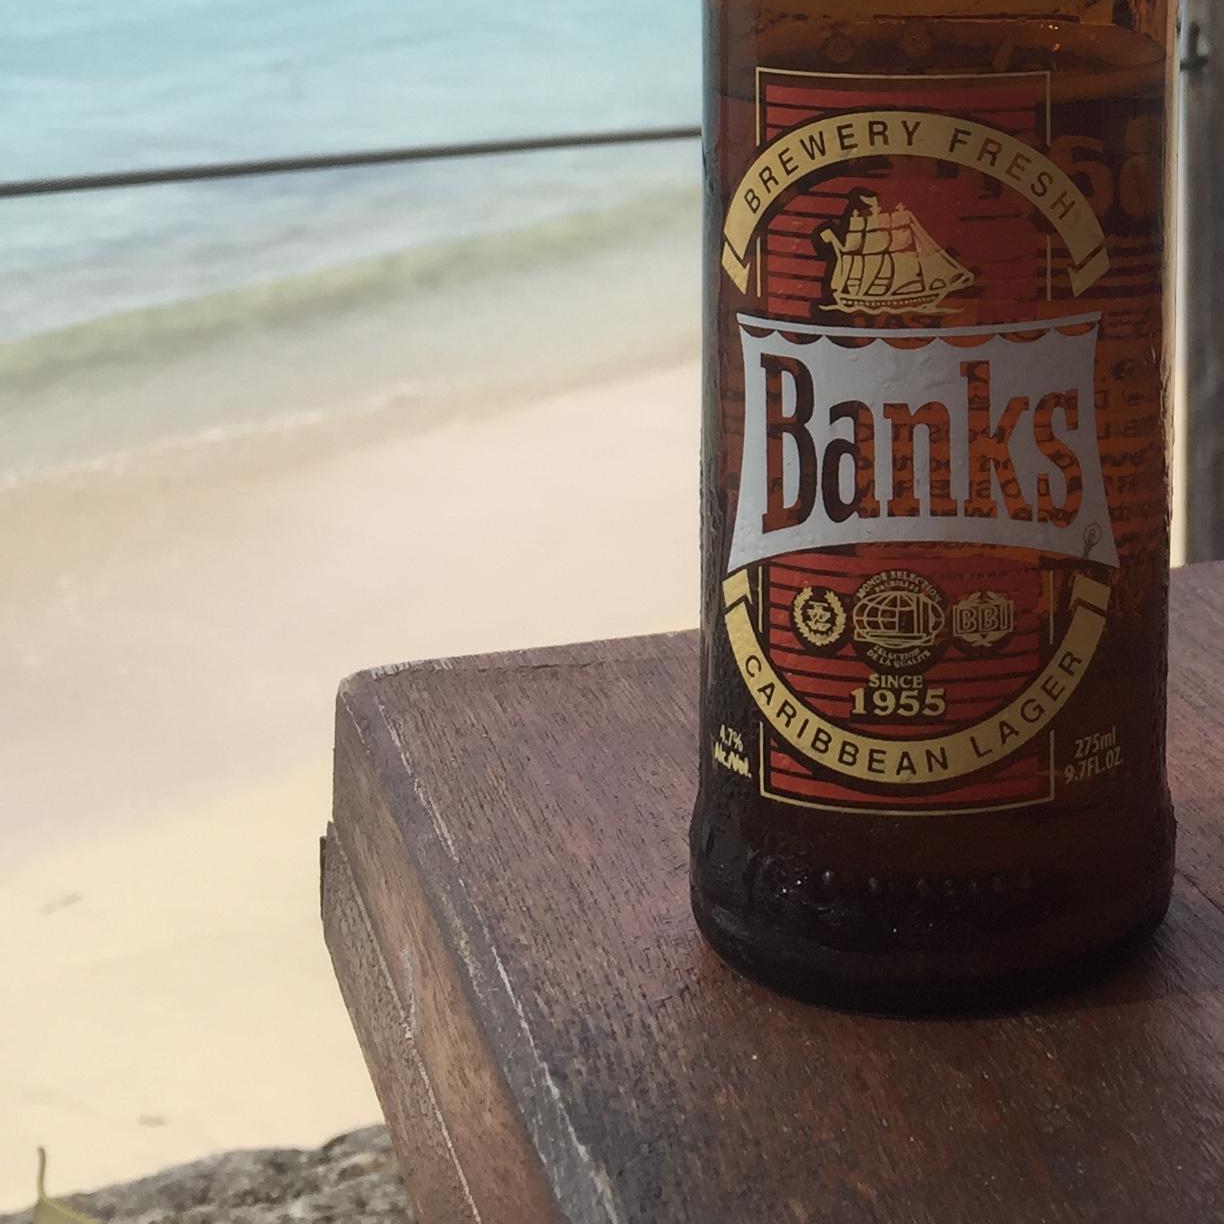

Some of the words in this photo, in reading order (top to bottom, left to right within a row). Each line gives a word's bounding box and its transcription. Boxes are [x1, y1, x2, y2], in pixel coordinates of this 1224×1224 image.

[744, 120, 923, 215] BREWERY
[947, 128, 1079, 221] FRESH
[760, 352, 1083, 534] Banks
[745, 654, 949, 776] CARIBBEAN
[969, 651, 1083, 760] LAGER
[851, 687, 947, 717] 1955
[868, 674, 924, 689] SINCE
[1074, 726, 1117, 759] 275ml
